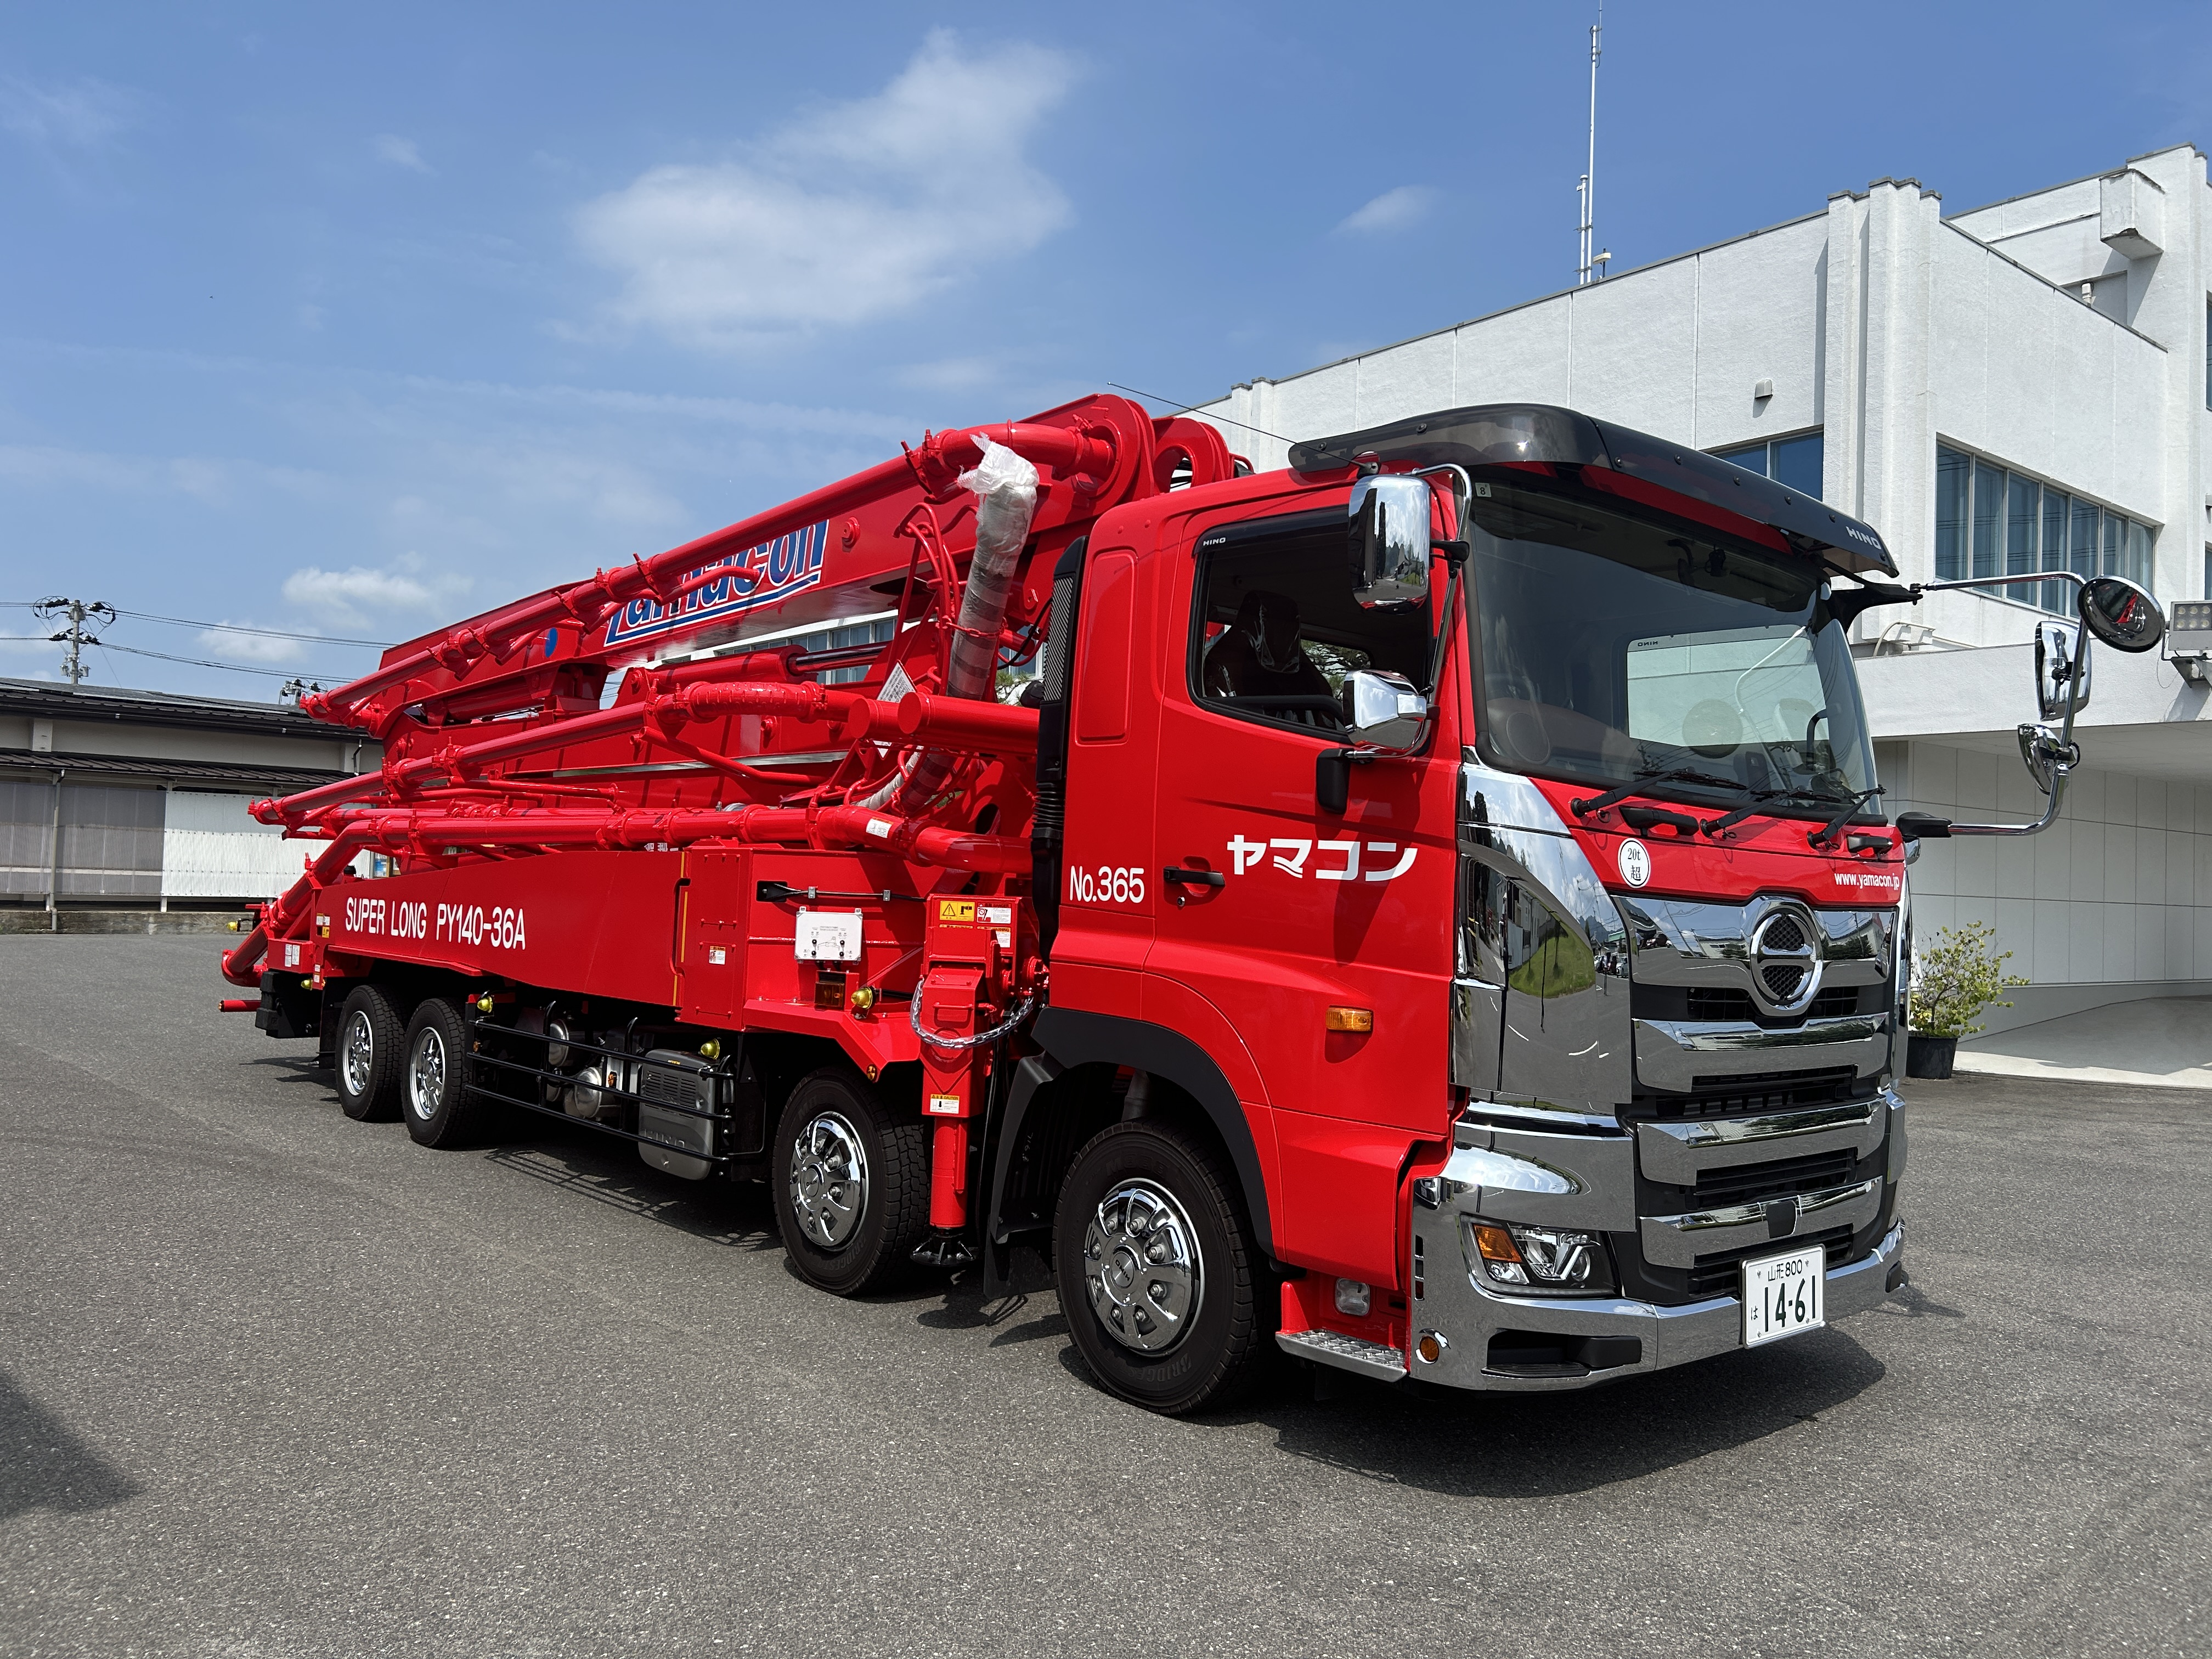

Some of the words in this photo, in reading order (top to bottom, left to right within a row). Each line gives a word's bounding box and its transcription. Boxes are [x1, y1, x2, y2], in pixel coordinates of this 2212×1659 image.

[1203, 537, 1226, 546] HINO
[1846, 526, 1881, 550] HINO
[1227, 834, 1419, 882] ヤマコン
[1628, 848, 1641, 860] 20t
[1070, 865, 1144, 904] No.365
[1630, 865, 1641, 881] 超
[1834, 872, 1900, 890] www.yamacon.jp
[346, 897, 386, 935] SUPER
[391, 901, 427, 939] LONG
[436, 903, 526, 950] PY140-36A
[1115, 1259, 1130, 1281] HINO
[1768, 1259, 1802, 1282] 山形800
[1751, 1306, 1758, 1321] は
[1764, 1275, 1816, 1333] 14-61
